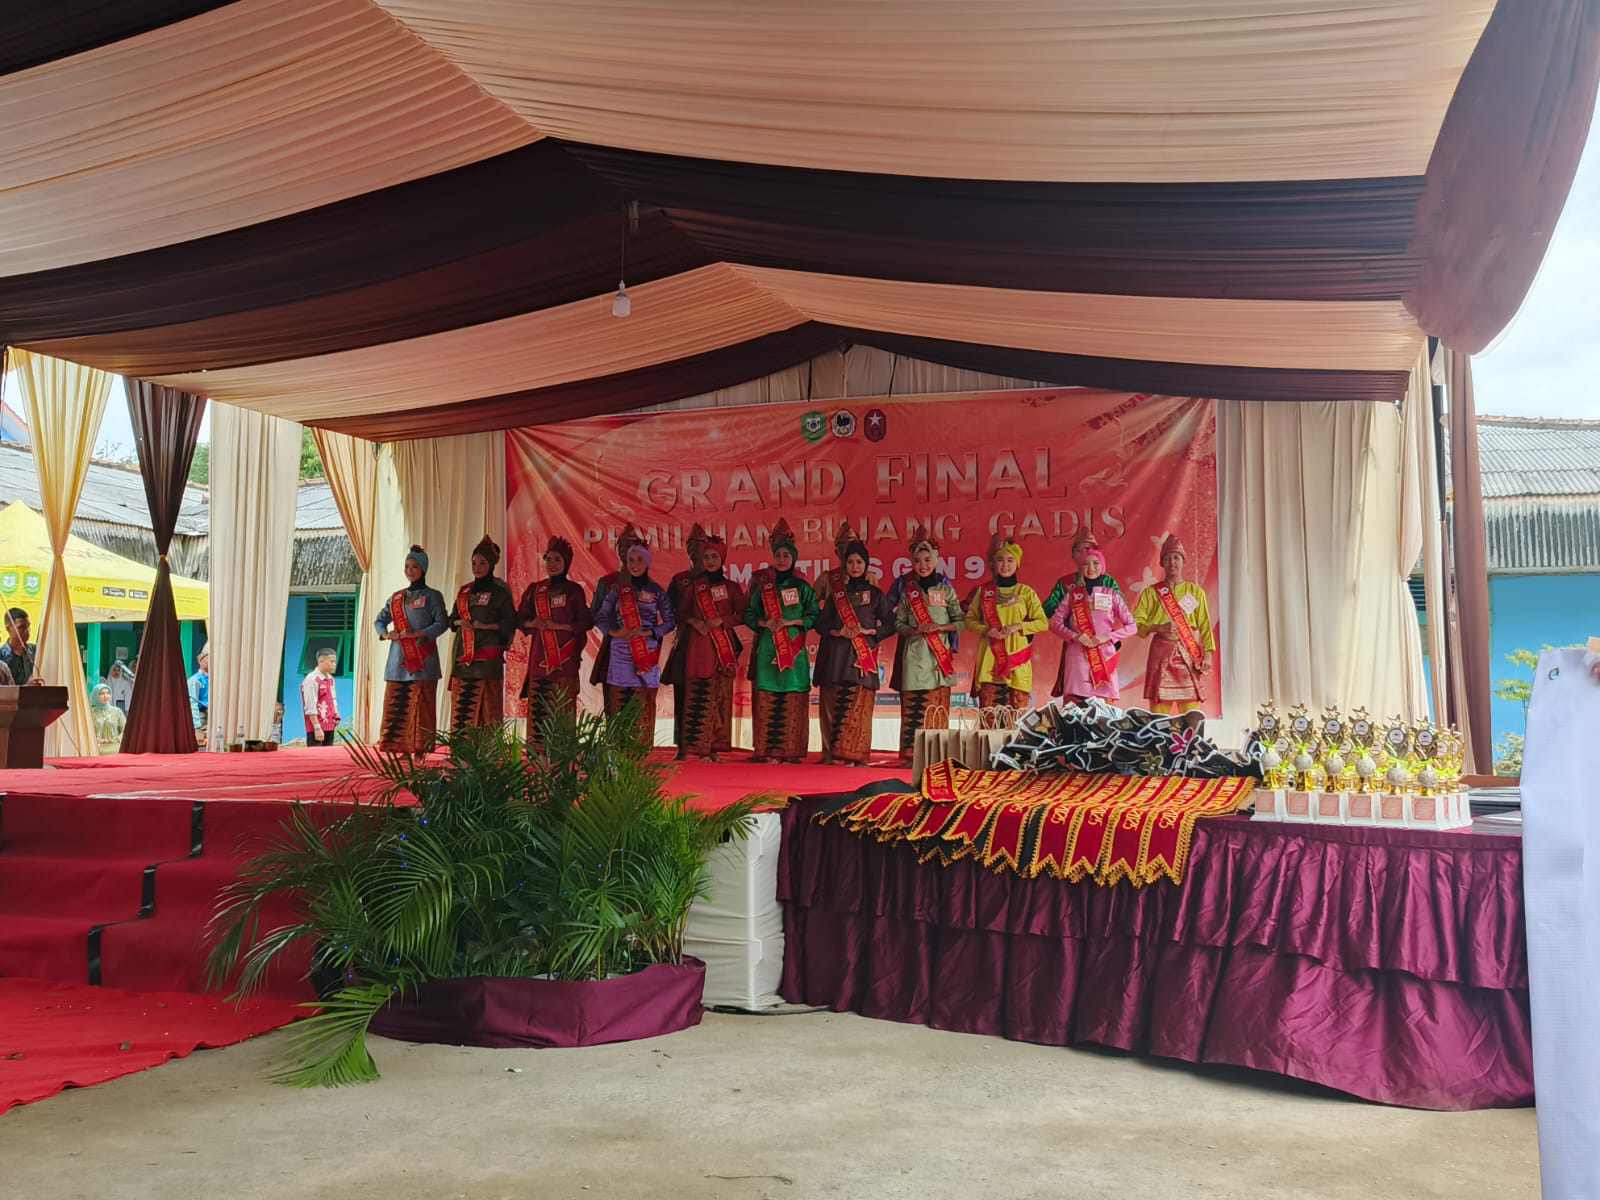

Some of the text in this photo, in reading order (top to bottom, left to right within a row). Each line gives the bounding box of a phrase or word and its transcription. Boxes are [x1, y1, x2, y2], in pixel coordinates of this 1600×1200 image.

[638, 447, 1068, 514] GRAND FINAL
[583, 520, 776, 551] PMILHAN
[988, 504, 1126, 540] GADIS
[892, 556, 956, 580] GN
[964, 556, 985, 580] 9
